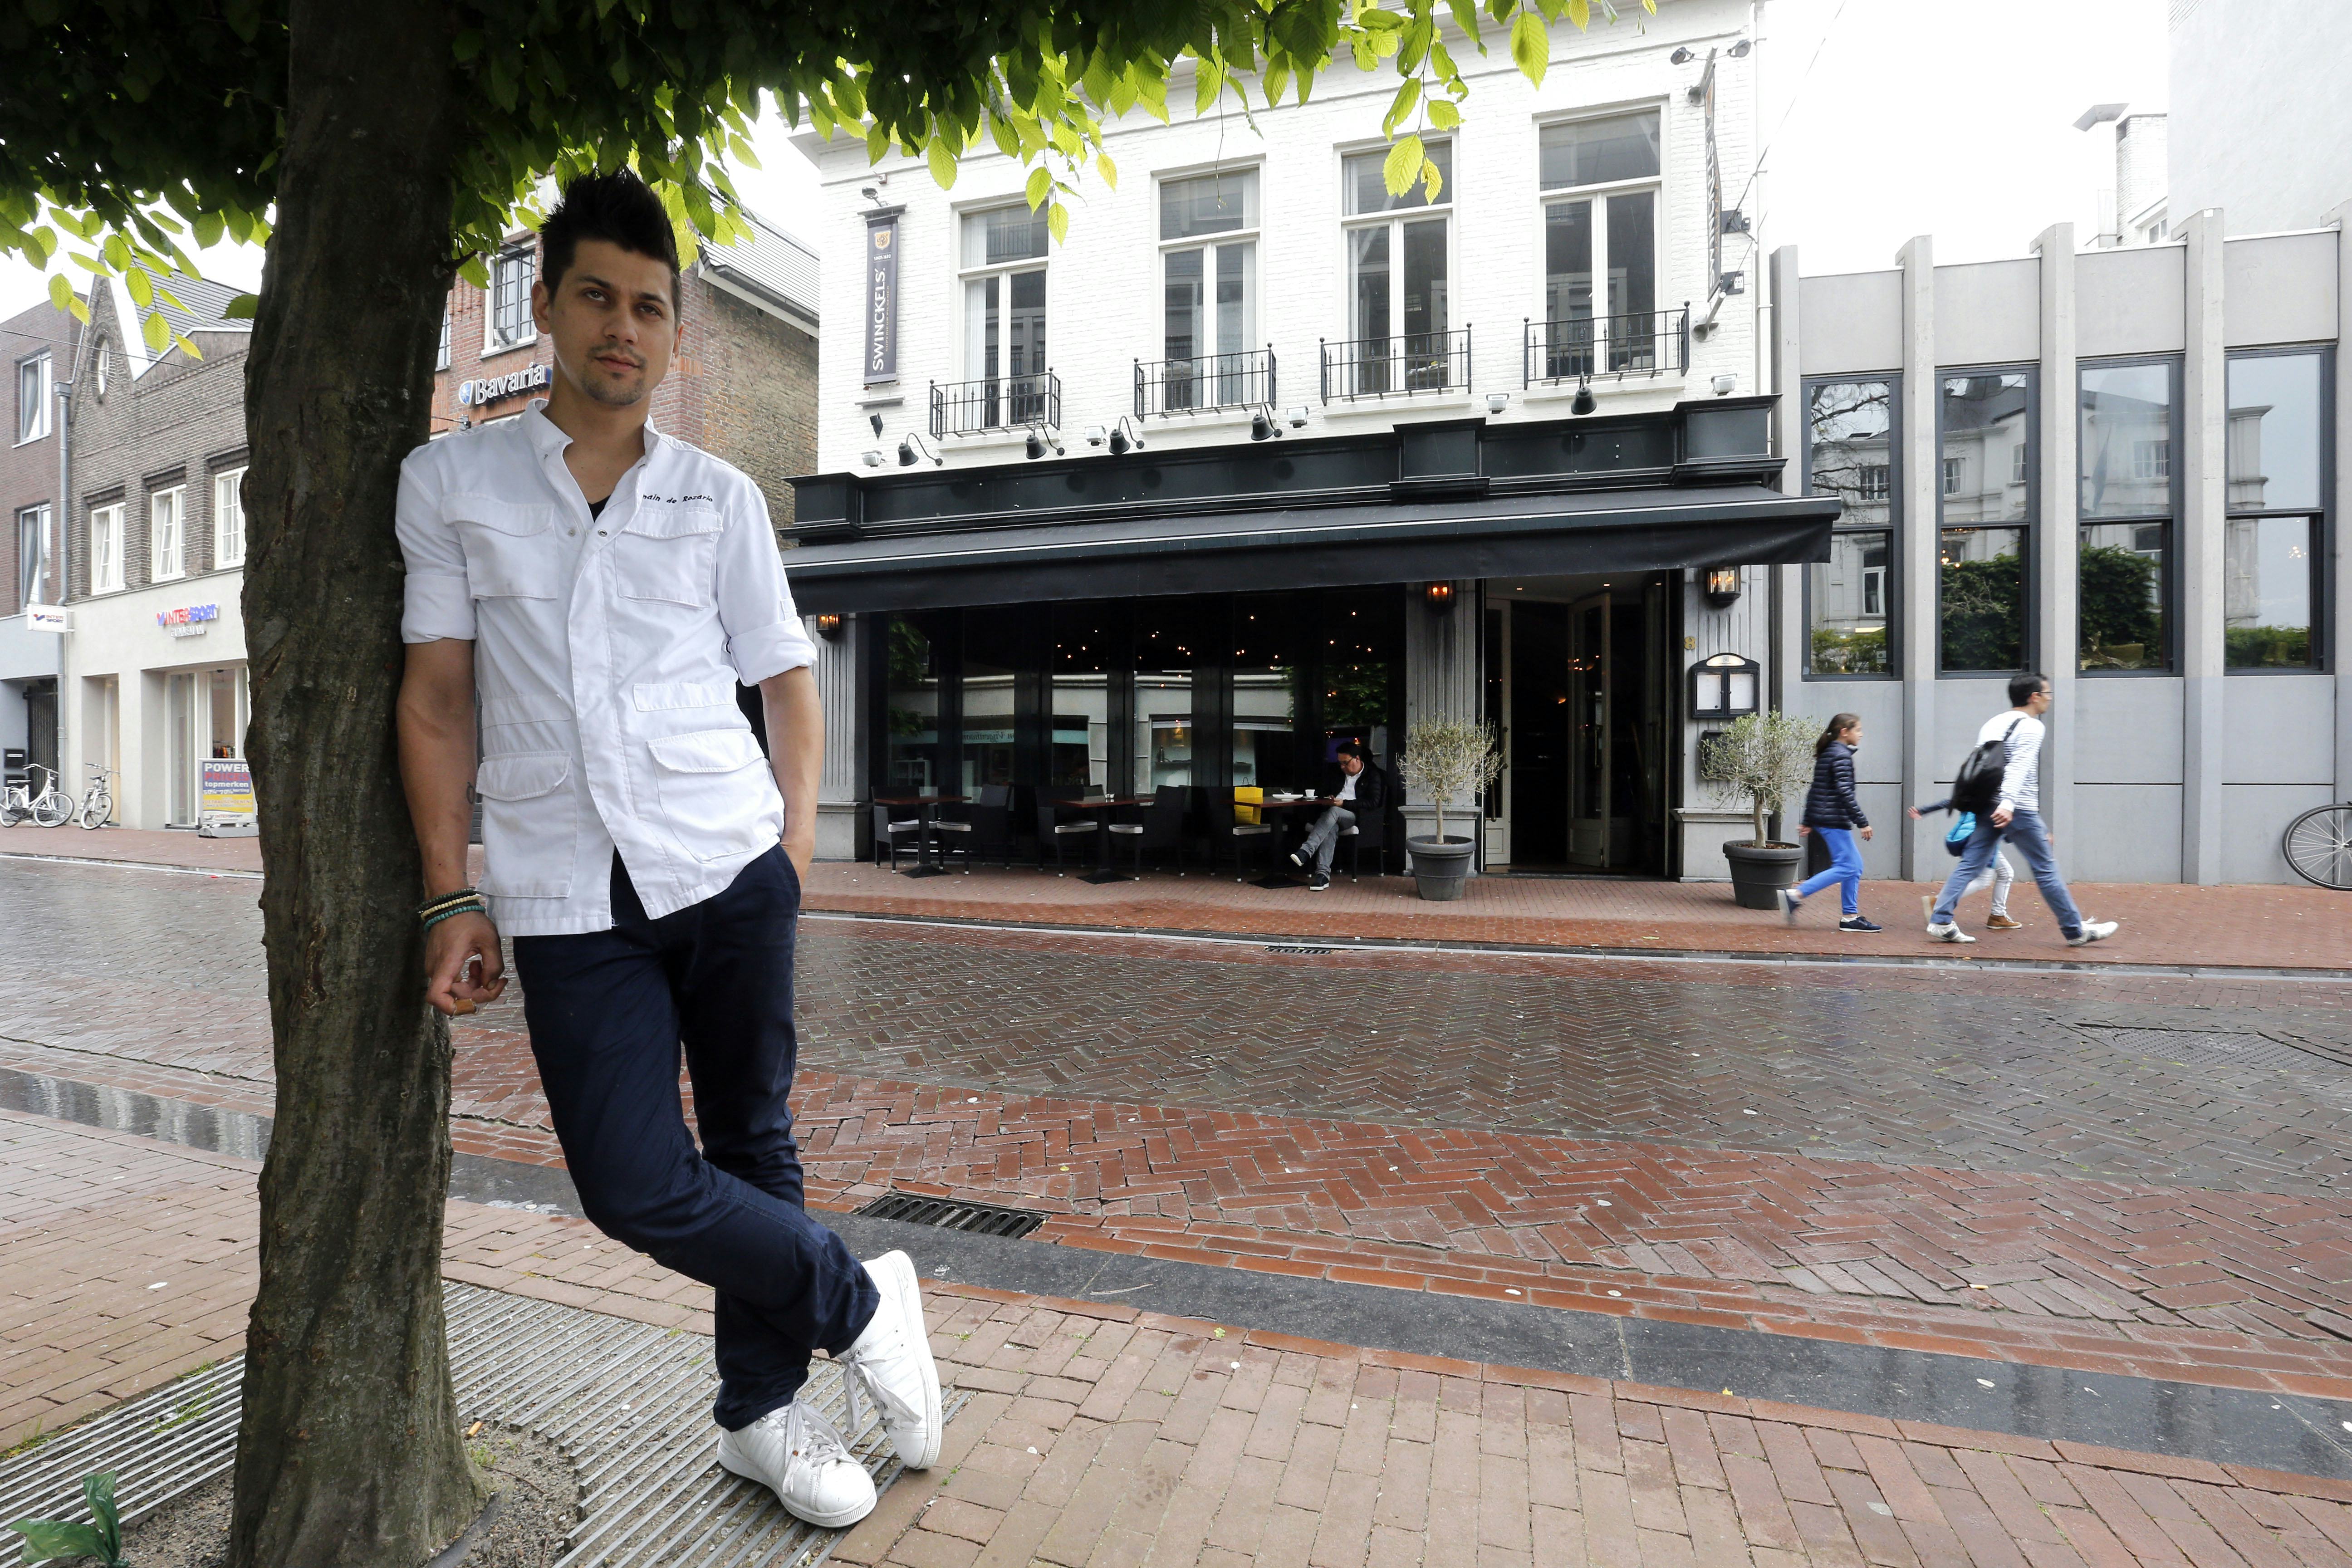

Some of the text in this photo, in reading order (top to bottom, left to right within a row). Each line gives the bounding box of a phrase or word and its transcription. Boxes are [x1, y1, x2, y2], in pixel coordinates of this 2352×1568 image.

[475, 362, 546, 405] Bavaria
[205, 763, 250, 772] POWER
[205, 772, 249, 781] PRICES
